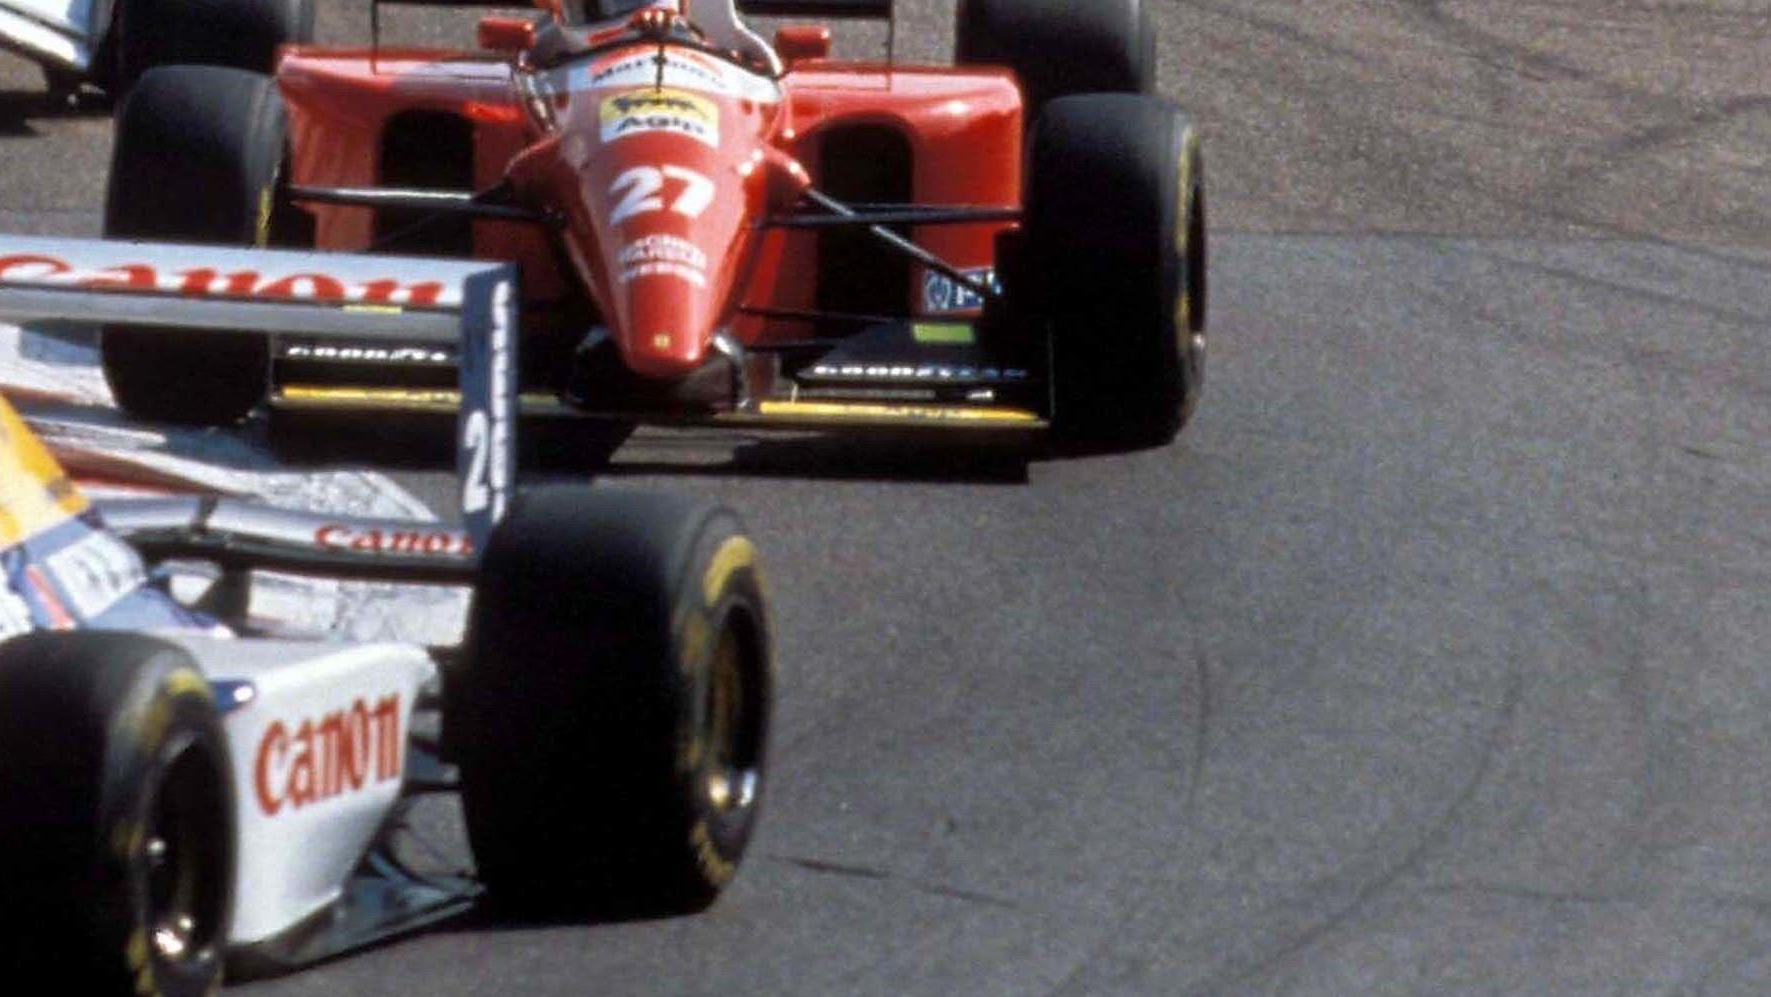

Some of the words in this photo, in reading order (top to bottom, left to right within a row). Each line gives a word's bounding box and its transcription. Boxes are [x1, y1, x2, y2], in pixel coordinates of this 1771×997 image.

[607, 165, 716, 225] 27
[462, 409, 490, 514] 2
[254, 690, 401, 817] Canon
